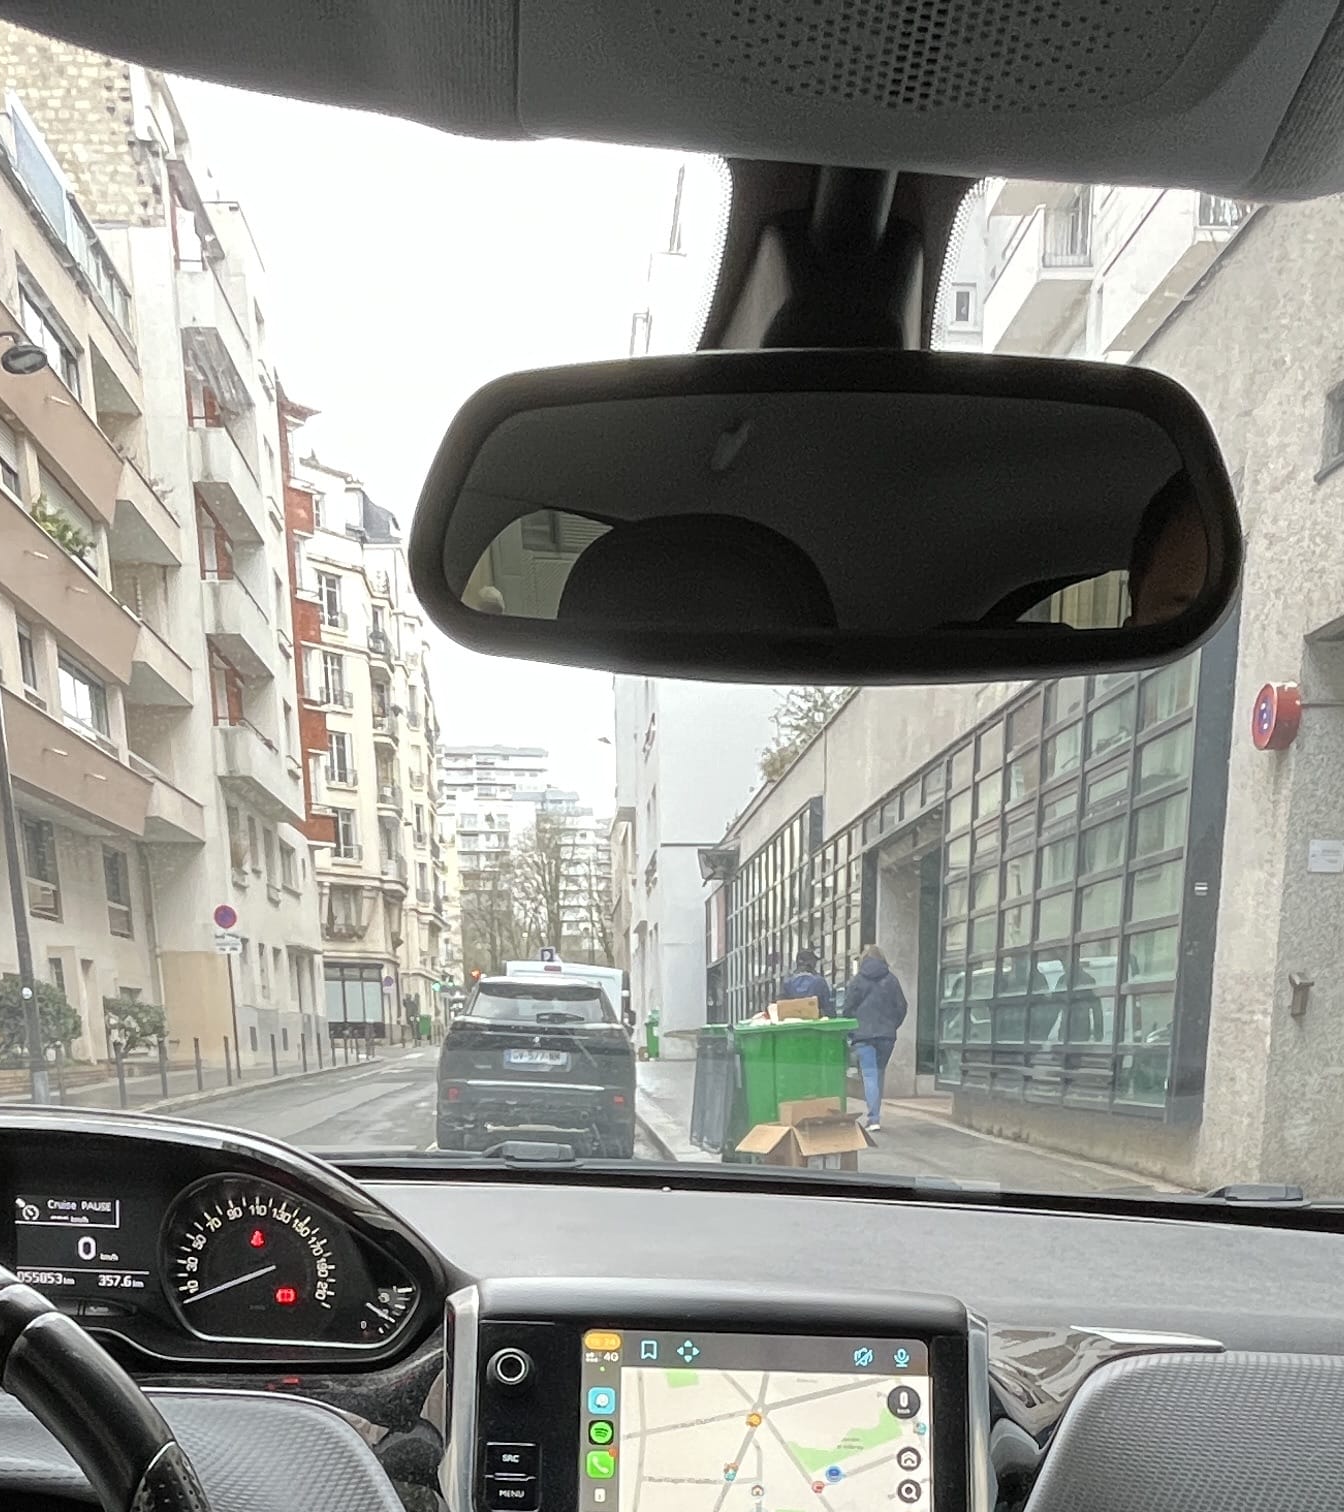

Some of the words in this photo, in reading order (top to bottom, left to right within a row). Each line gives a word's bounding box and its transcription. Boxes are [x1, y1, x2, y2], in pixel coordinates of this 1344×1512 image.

[47, 1199, 76, 1211] Cruise
[81, 1201, 112, 1212] PAUSE
[226, 1206, 243, 1221] 90
[249, 1204, 267, 1217] 110
[272, 1207, 291, 1225] 130
[206, 1217, 223, 1233] 70
[292, 1217, 312, 1238] 150
[78, 1236, 96, 1260] 0
[191, 1233, 207, 1251] 50
[307, 1236, 324, 1257] 170
[186, 1256, 199, 1273] 30
[315, 1257, 329, 1279] 190
[98, 1274, 132, 1288] 357.6
[314, 1281, 329, 1300] 210
[501, 1453, 520, 1464] SRC
[498, 1489, 525, 1498] MENU
